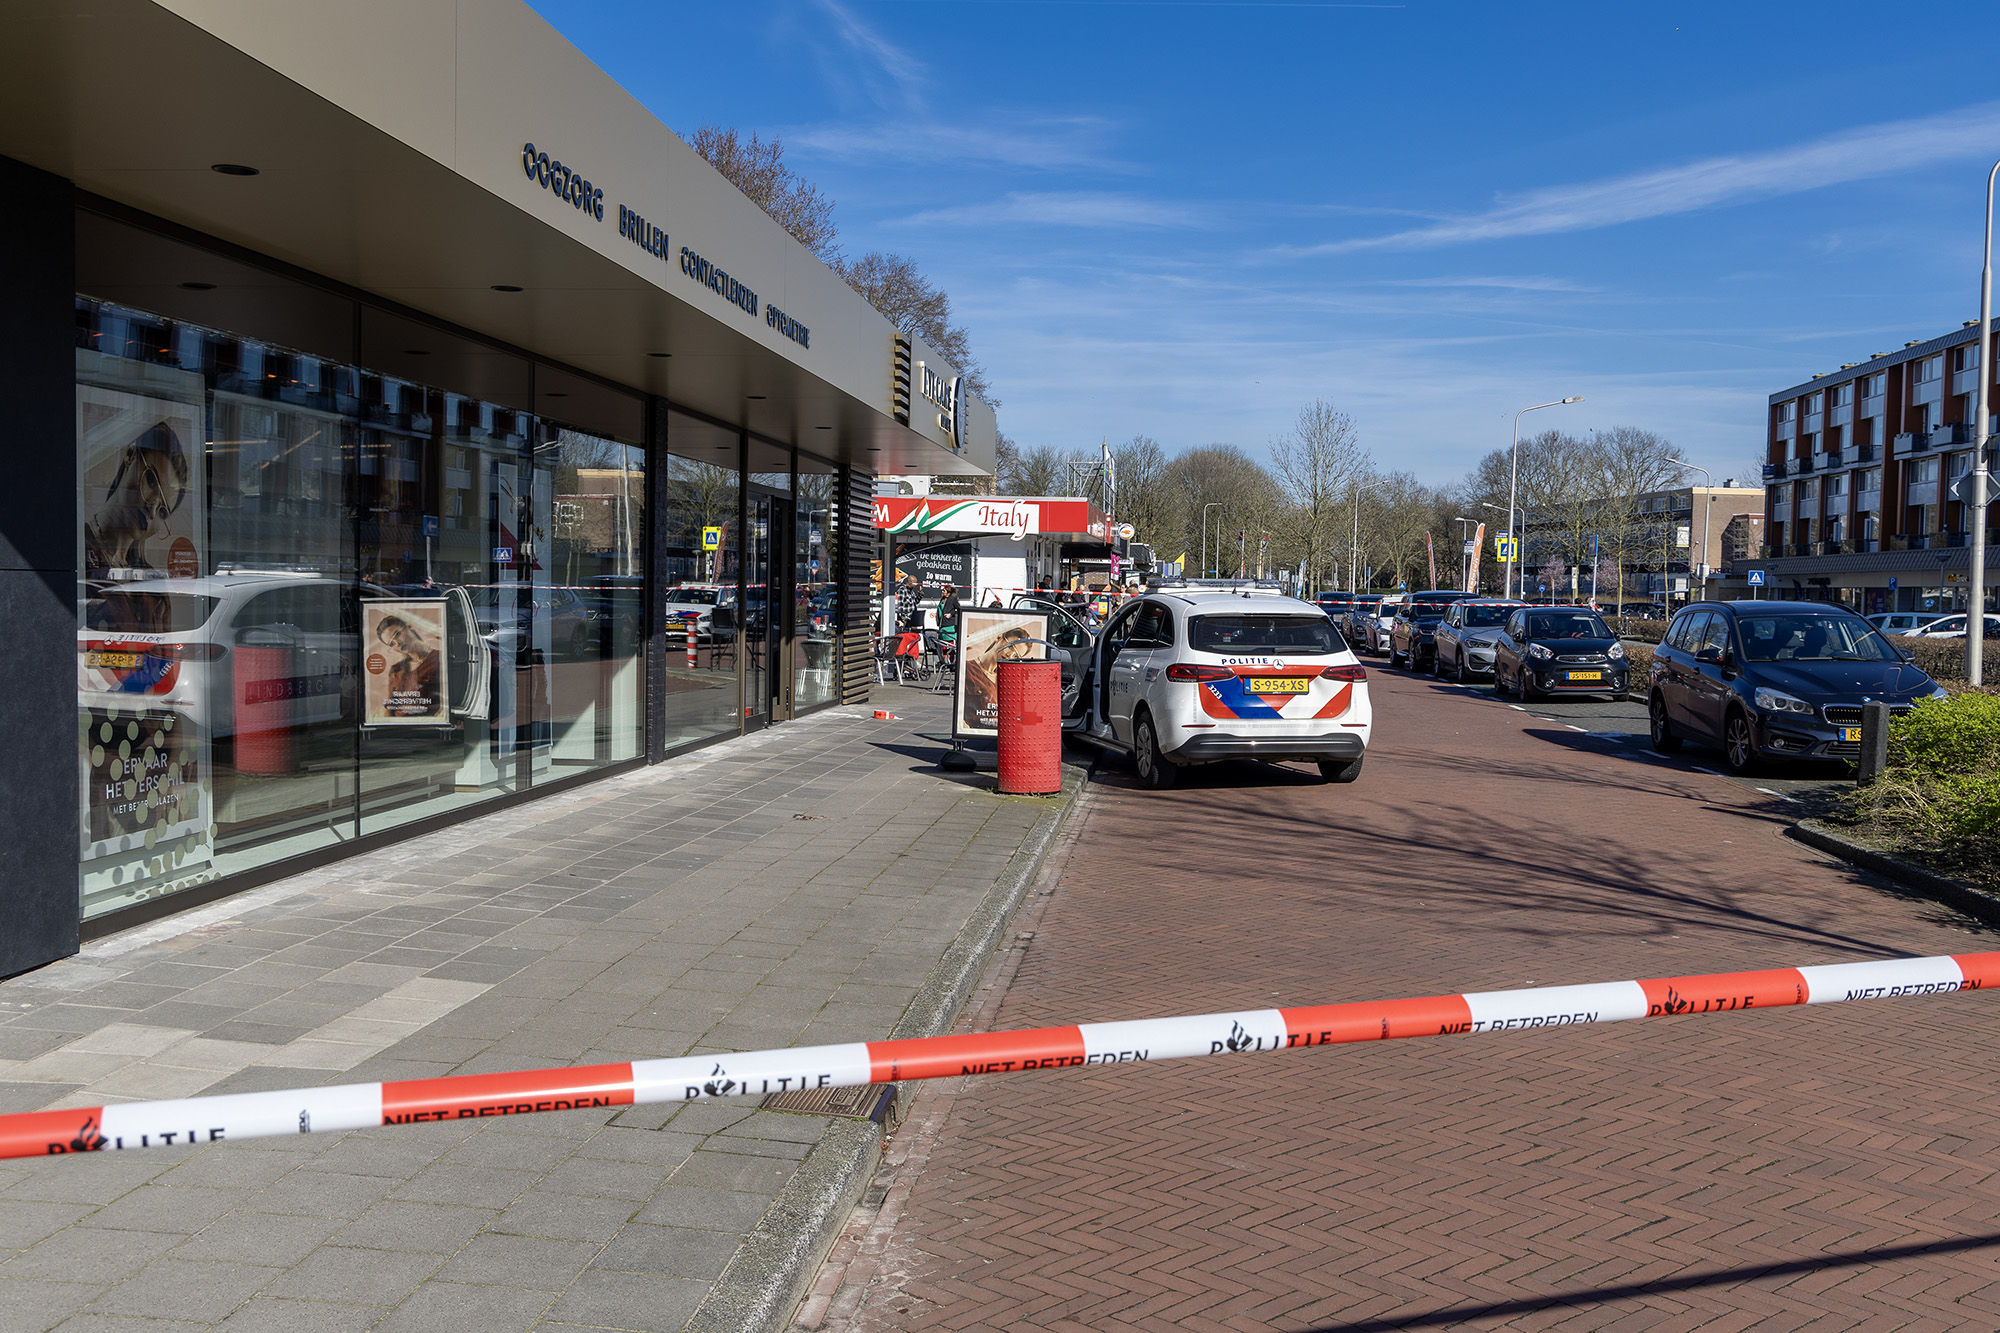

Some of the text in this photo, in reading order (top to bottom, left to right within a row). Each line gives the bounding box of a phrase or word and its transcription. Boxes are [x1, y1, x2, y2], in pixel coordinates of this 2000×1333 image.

[522, 142, 810, 350] OOGZORG BRILLEN CONTACTLENZEN OPTOMETRIE
[979, 500, 1029, 538] Italy
[916, 561, 962, 571] gebakken vis
[926, 572, 952, 581] Zo warm
[1254, 680, 1304, 690] S-954-XS
[976, 709, 990, 717] HET
[123, 753, 168, 775] ERAR
